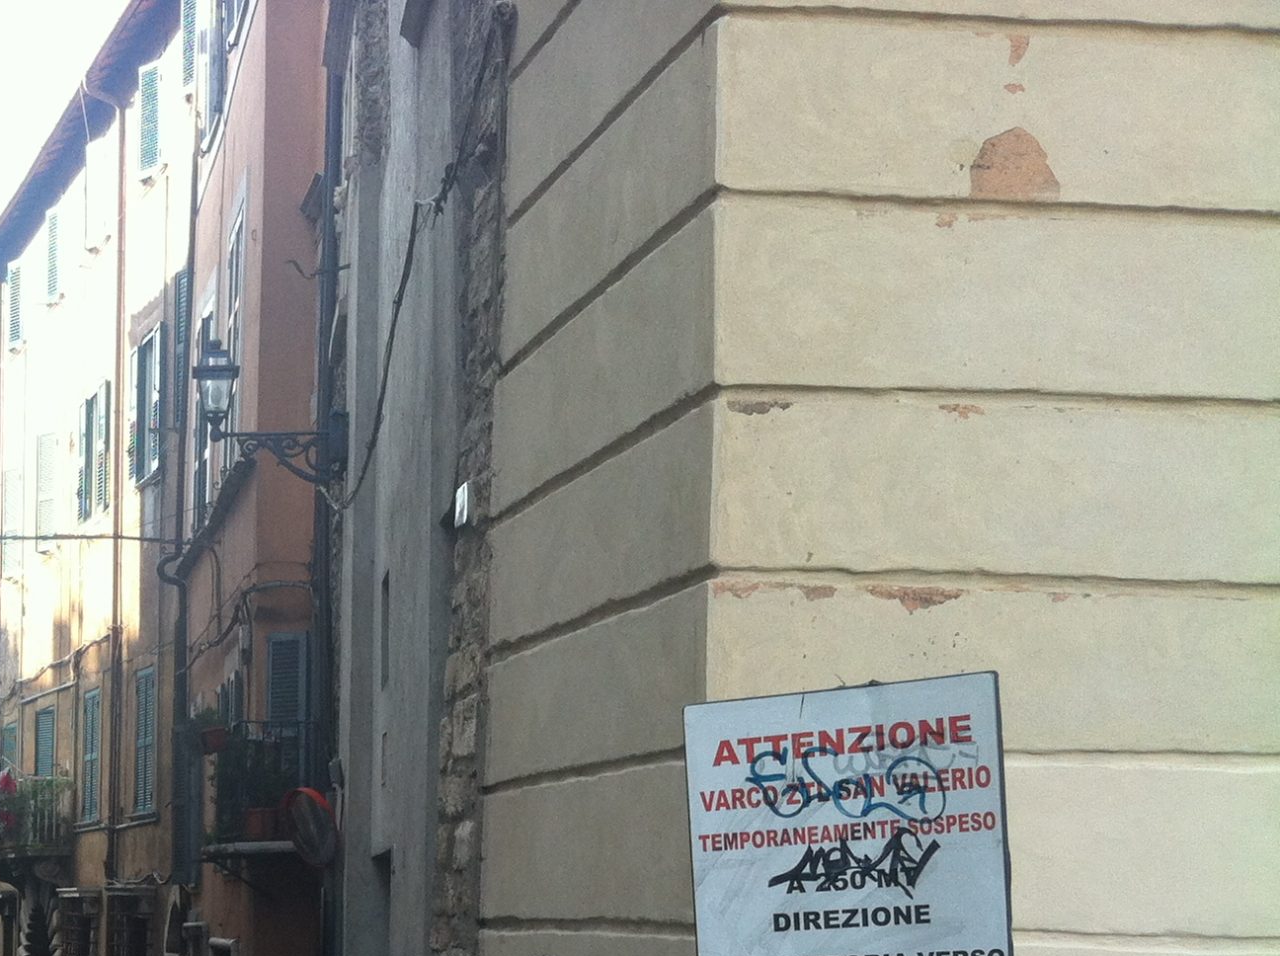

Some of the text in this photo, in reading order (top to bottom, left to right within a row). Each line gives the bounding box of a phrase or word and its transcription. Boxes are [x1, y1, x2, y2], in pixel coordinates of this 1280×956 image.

[712, 714, 973, 767] ATTENZIONE
[700, 765, 991, 812] VARCO ZTL SAN VALERIO
[698, 811, 997, 853] TEMPORANEAMENTE SOSPESO
[786, 872, 807, 894] A
[816, 869, 867, 893] 250
[773, 904, 931, 932] DIREZIONE
